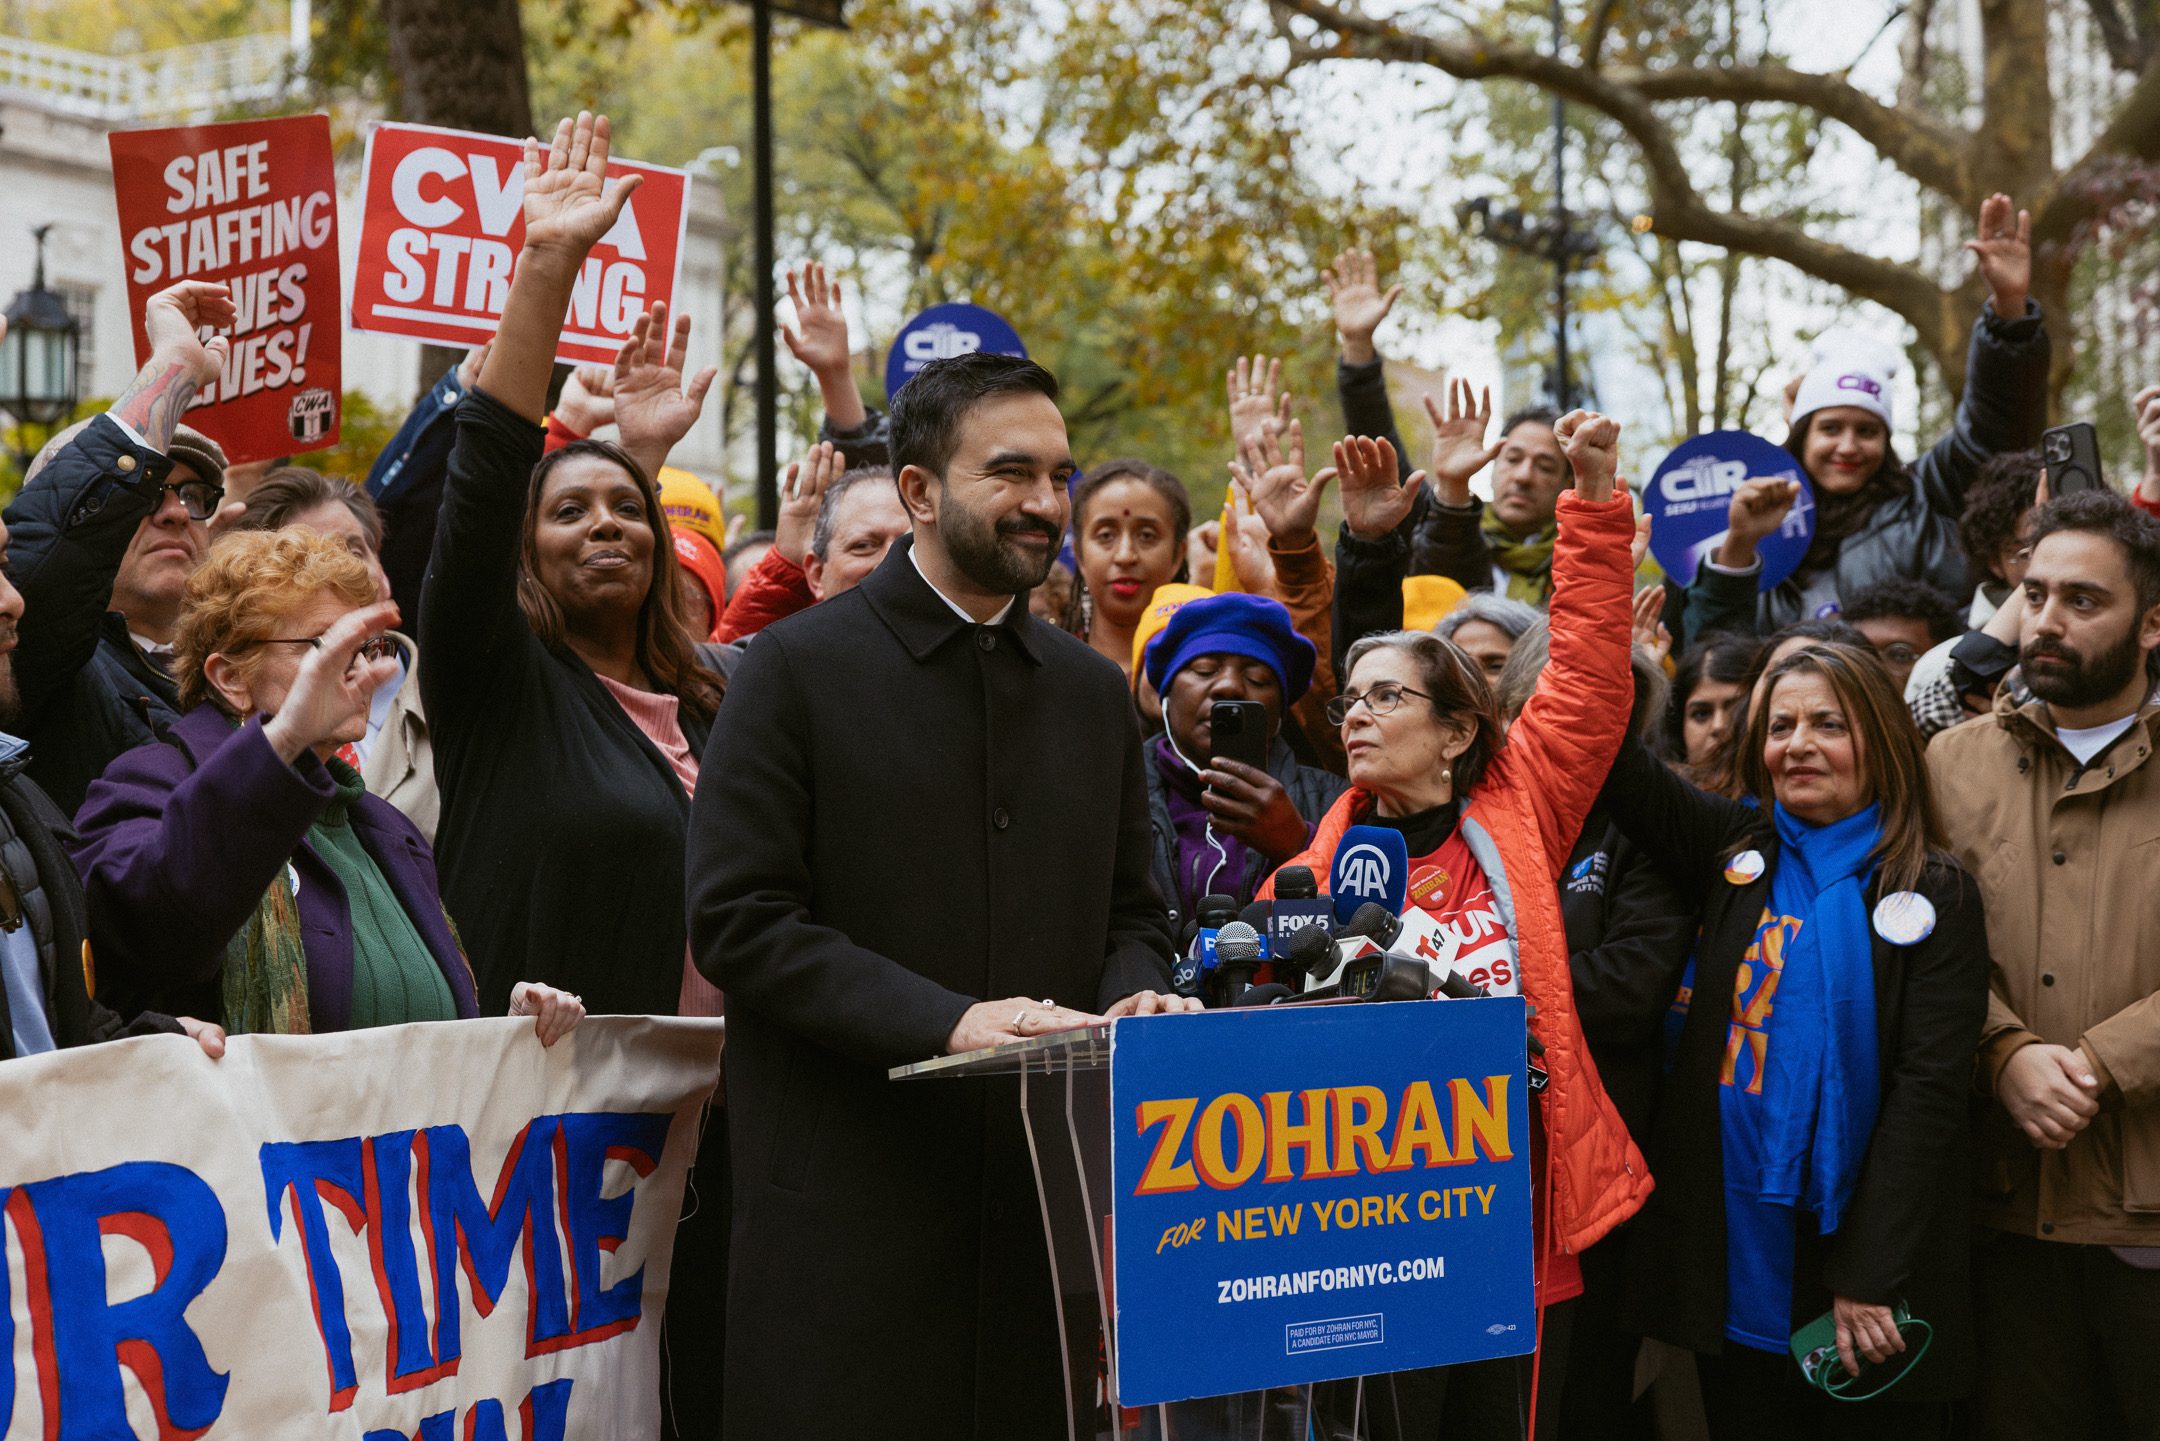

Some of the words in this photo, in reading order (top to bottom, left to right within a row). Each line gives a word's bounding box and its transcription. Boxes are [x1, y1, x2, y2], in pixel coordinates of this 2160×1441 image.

[163, 139, 270, 214] SAFE
[130, 190, 332, 285] STAFFING
[197, 262, 308, 343] VES
[383, 228, 647, 334] STRNG
[185, 322, 312, 413] VES!
[295, 393, 329, 413] CWA
[1660, 455, 1748, 502] CIR
[1338, 857, 1387, 900] AA
[1411, 872, 1449, 900] ZOHRAN
[1431, 928, 1446, 951] 47
[1173, 966, 1196, 987] ab
[1133, 1073, 1515, 1197] ZOHRAN
[1156, 1216, 1207, 1254] FOR
[1217, 1203, 1303, 1242] NEW
[1311, 1192, 1410, 1231] YORK
[1417, 1184, 1497, 1221] CITY
[259, 1112, 676, 1414] TIME
[1217, 1256, 1446, 1304] ZOHRANFORNYC.COM
[1290, 1328, 1304, 1338] PAID
[1305, 1326, 1317, 1336] FOR
[1318, 1325, 1326, 1335] BY
[1327, 1322, 1351, 1334] ZOHRAN
[1352, 1320, 1363, 1330] FOR
[1292, 1339, 1297, 1349] A
[1298, 1336, 1331, 1348] CANDIDATE
[1332, 1334, 1344, 1343] FOR
[1344, 1332, 1357, 1342] NYC
[1357, 1329, 1378, 1340] MAYOR
